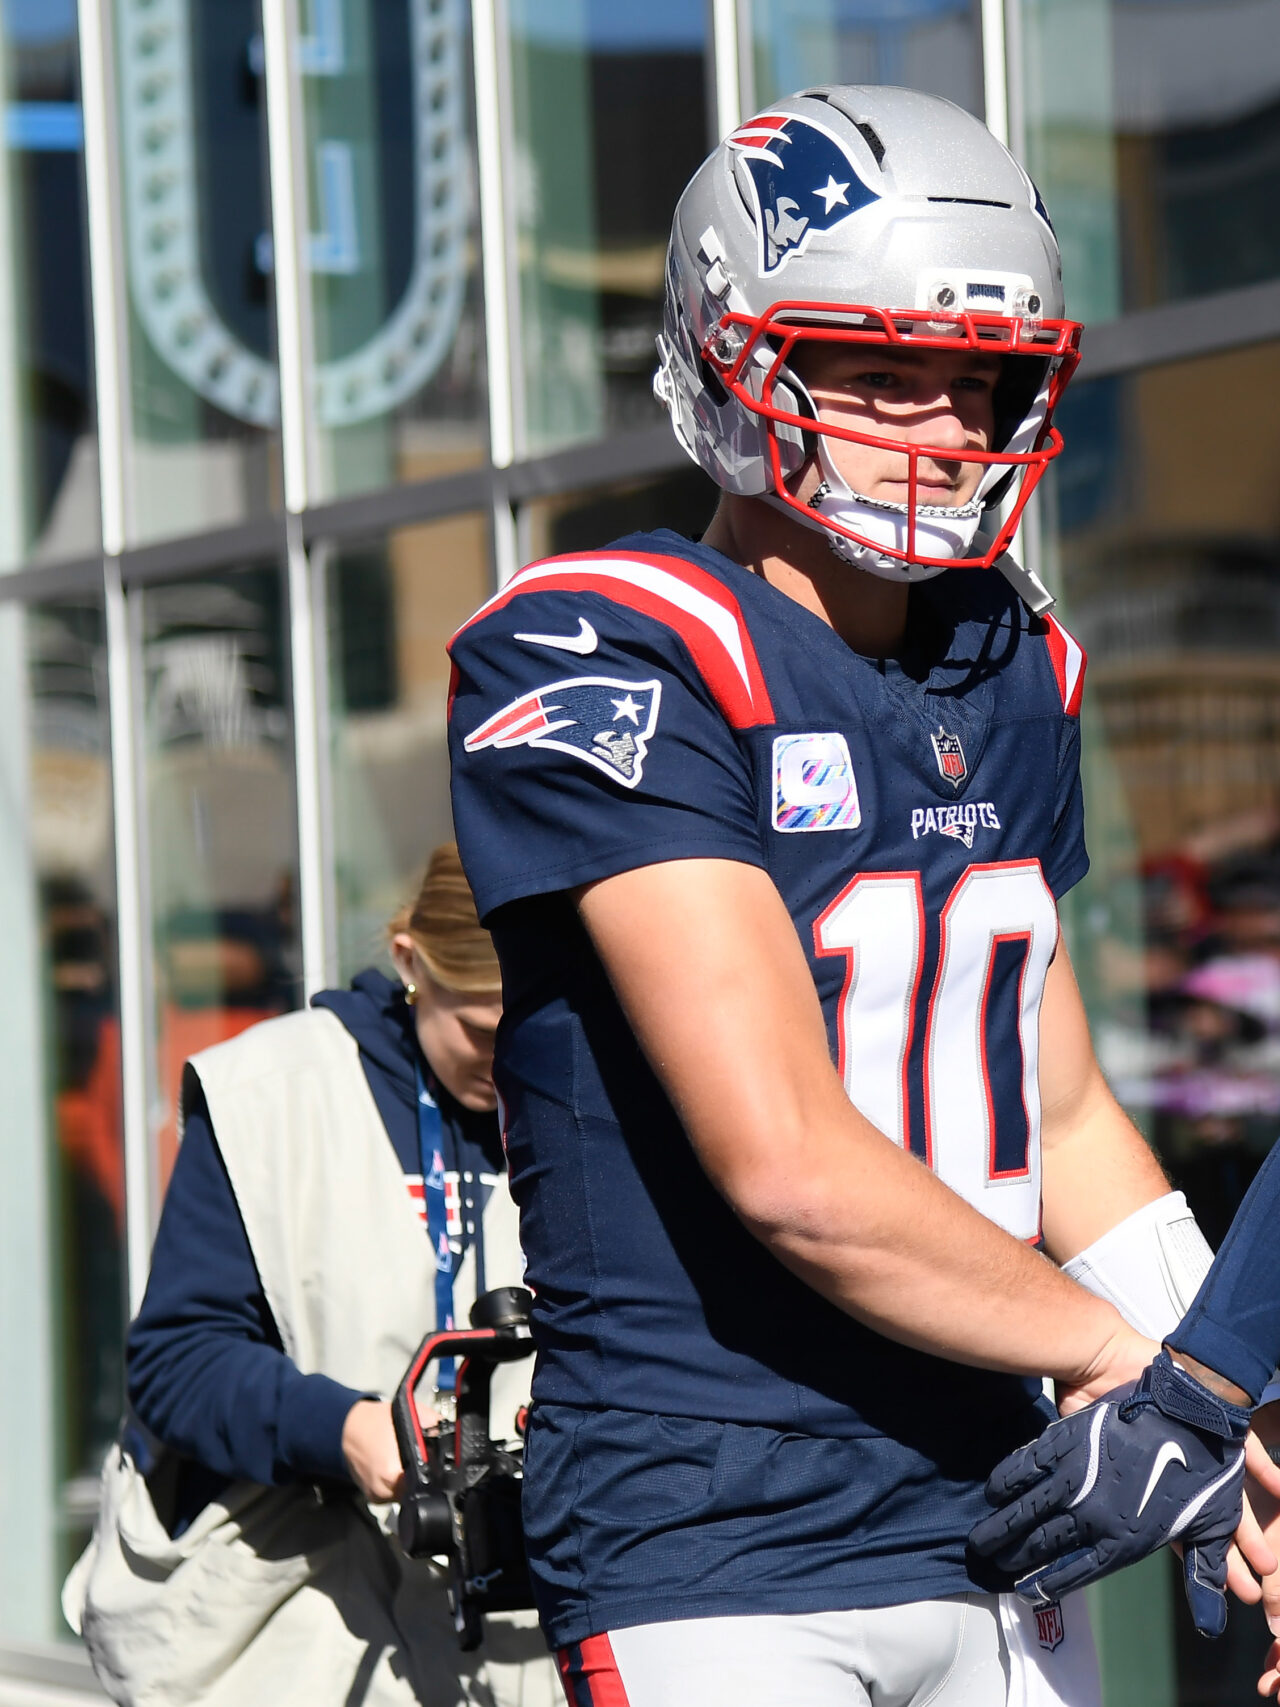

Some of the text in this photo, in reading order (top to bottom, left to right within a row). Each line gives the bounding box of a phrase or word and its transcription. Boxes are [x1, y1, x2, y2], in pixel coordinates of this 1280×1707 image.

[779, 741, 852, 806] C
[942, 754, 965, 777] NFL
[911, 802, 1001, 840] PATRIOTS
[813, 857, 1060, 1246] 10
[1035, 1608, 1062, 1644] NFL
